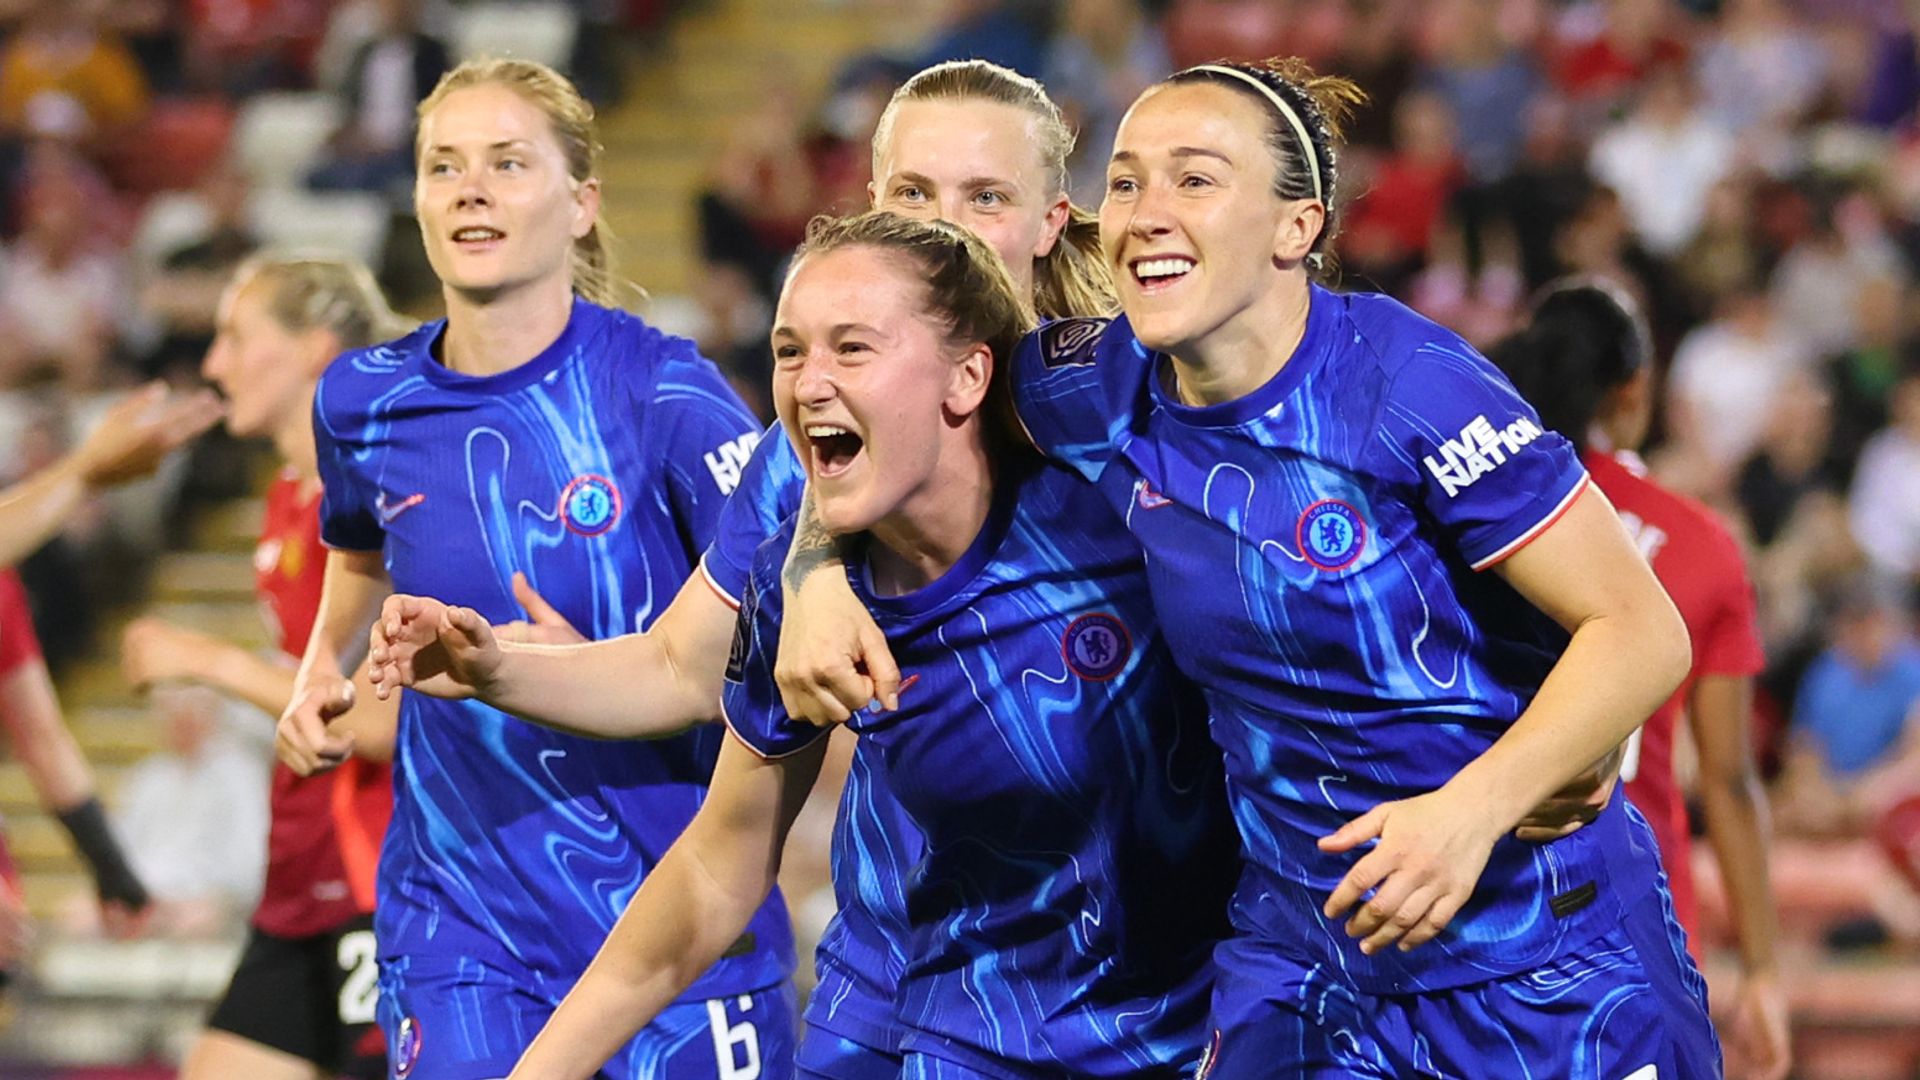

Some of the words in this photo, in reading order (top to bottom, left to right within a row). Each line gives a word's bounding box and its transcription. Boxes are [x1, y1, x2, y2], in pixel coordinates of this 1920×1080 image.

[1423, 414, 1497, 479] LIVE
[1438, 416, 1541, 498] NATION
[706, 994, 761, 1080] 6
